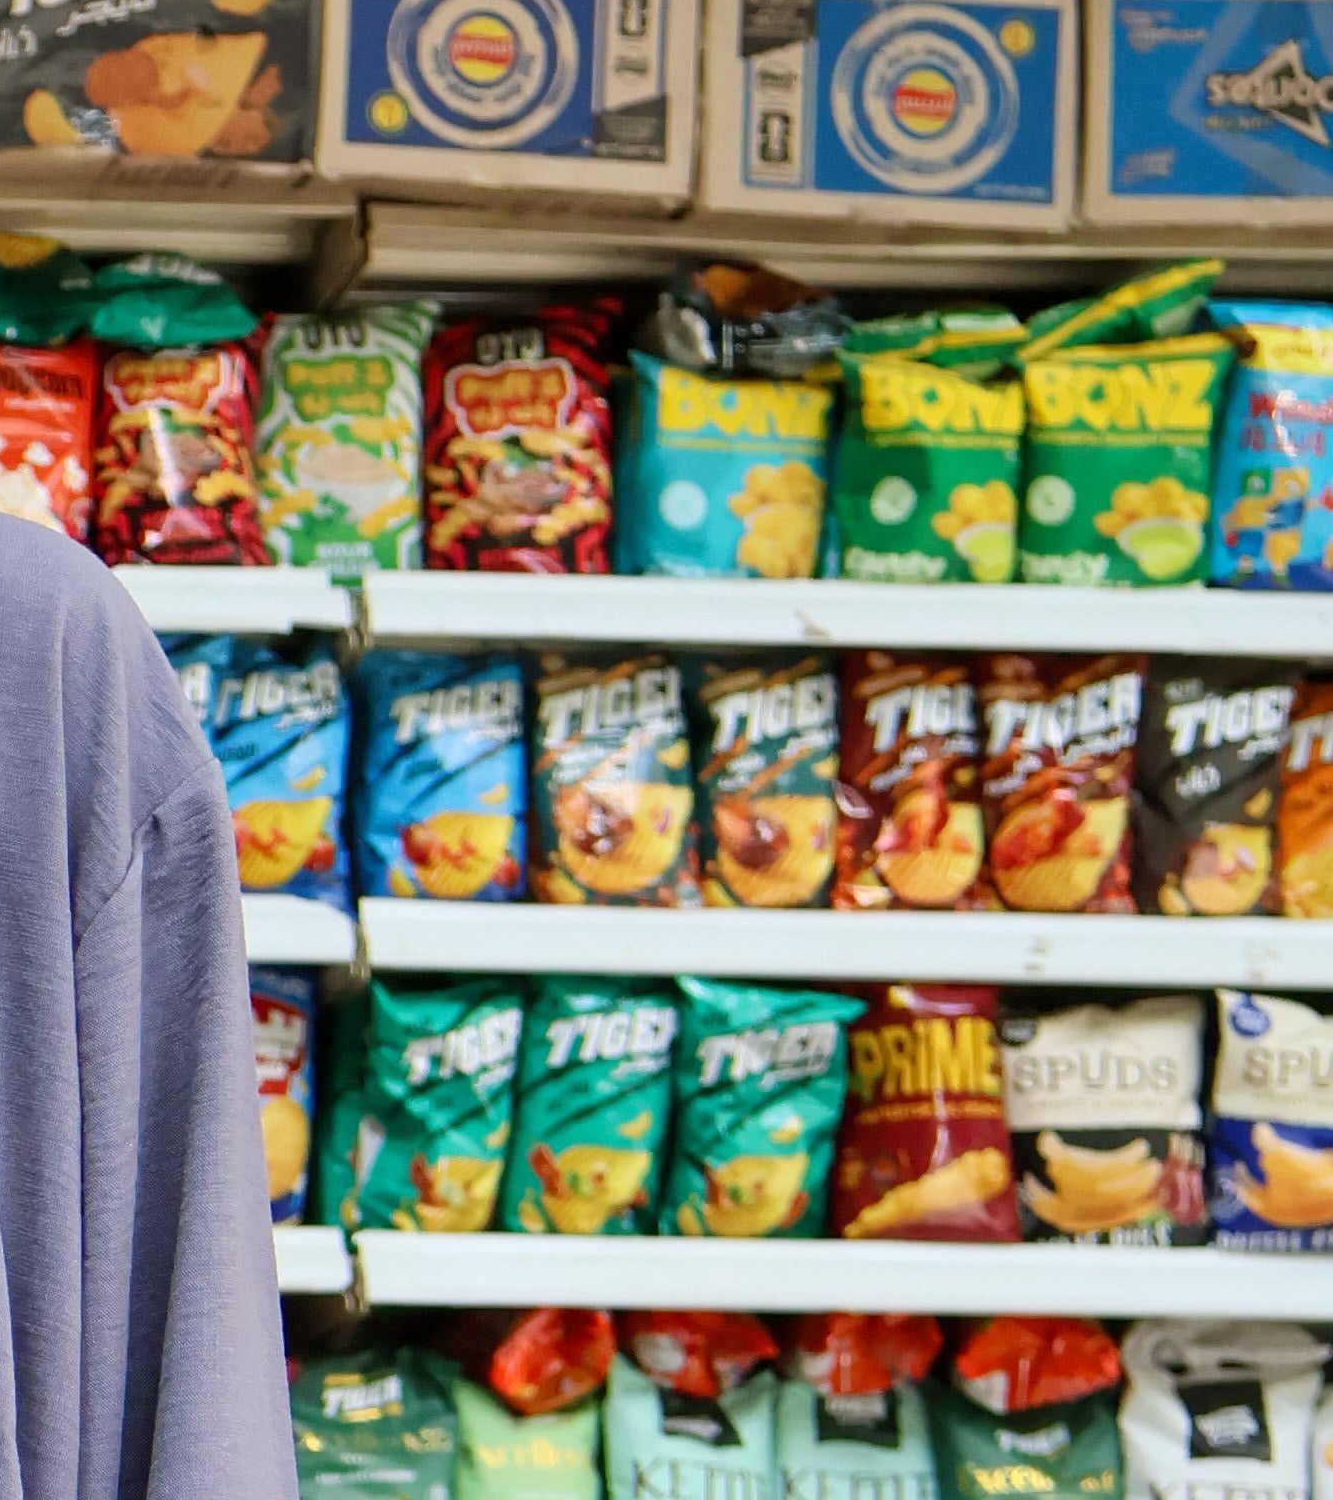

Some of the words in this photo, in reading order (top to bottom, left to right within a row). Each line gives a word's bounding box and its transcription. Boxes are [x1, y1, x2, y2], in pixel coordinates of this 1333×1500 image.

[660, 374, 831, 441] BONZ
[1025, 359, 1216, 431] BONZ
[986, 673, 1144, 754] TIGER
[852, 1016, 1001, 1101] PRIME
[1010, 1049, 1180, 1096] SPUDS
[1241, 1047, 1333, 1091] SPU
